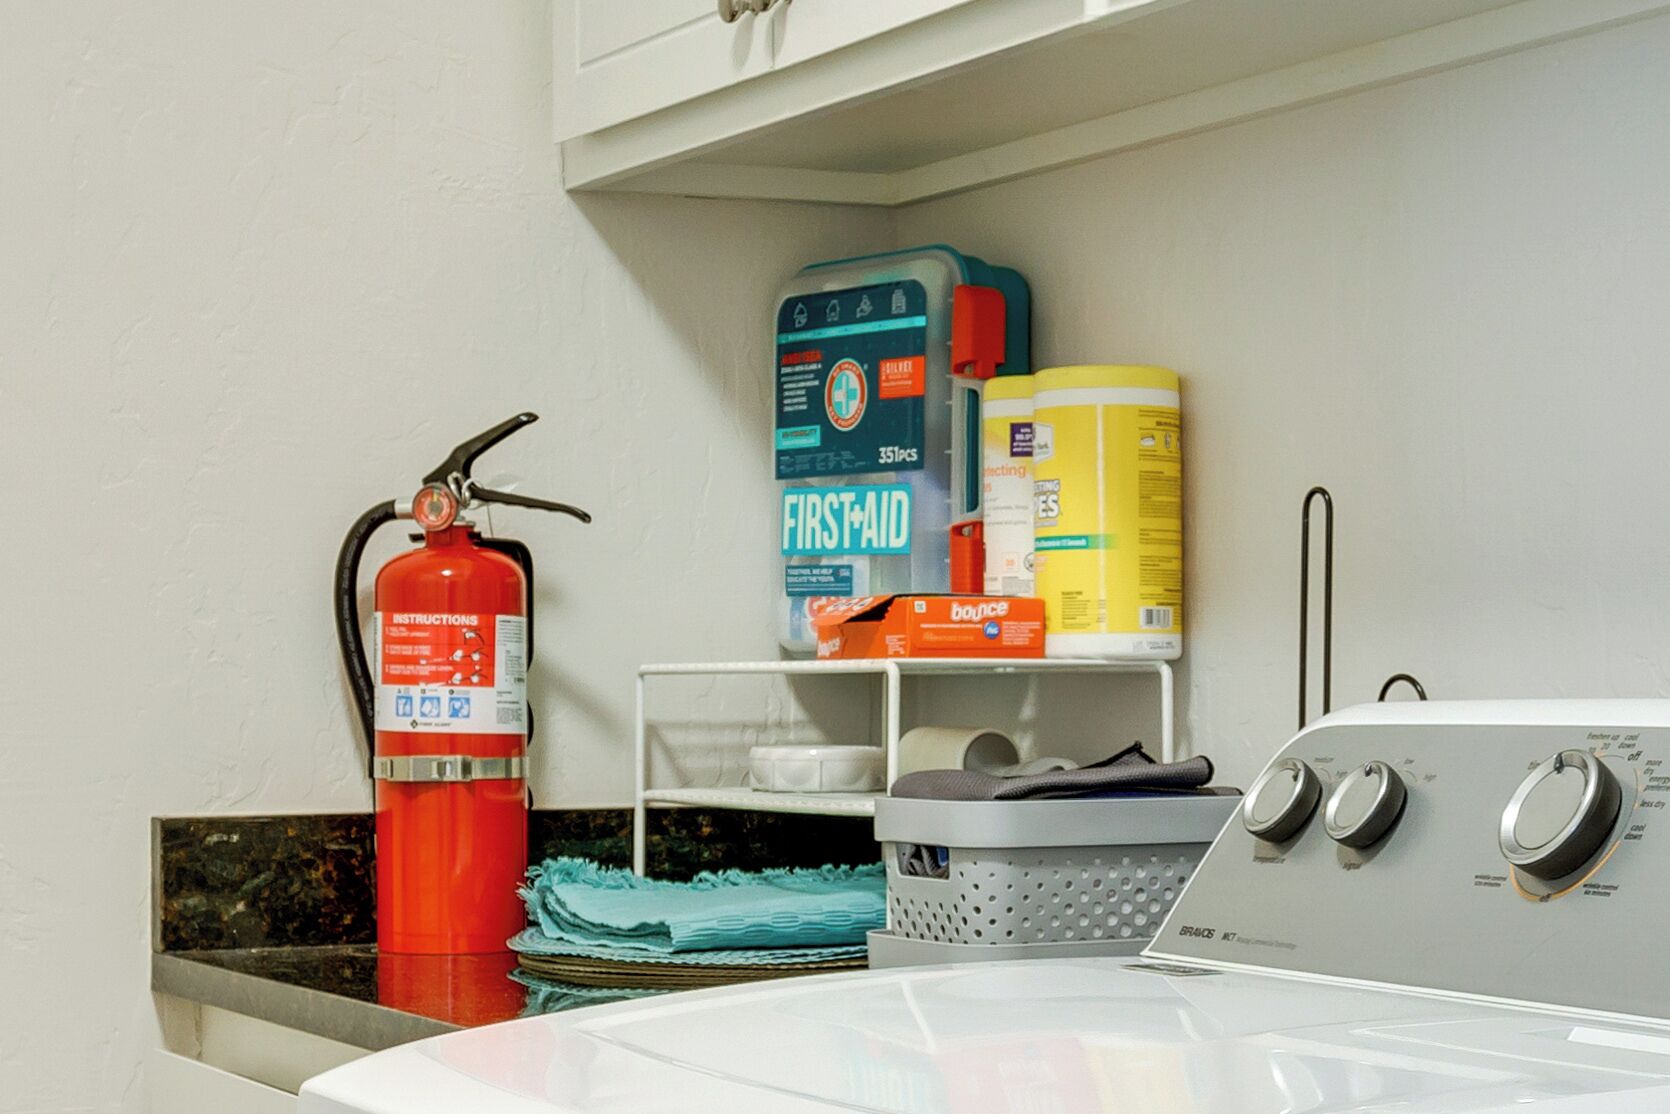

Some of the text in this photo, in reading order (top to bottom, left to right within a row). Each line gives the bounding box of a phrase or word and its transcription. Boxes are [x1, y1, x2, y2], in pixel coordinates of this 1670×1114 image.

[951, 601, 1009, 622] bounce
[393, 614, 479, 626] INSTRUCTIONS
[1627, 750, 1644, 762] off
